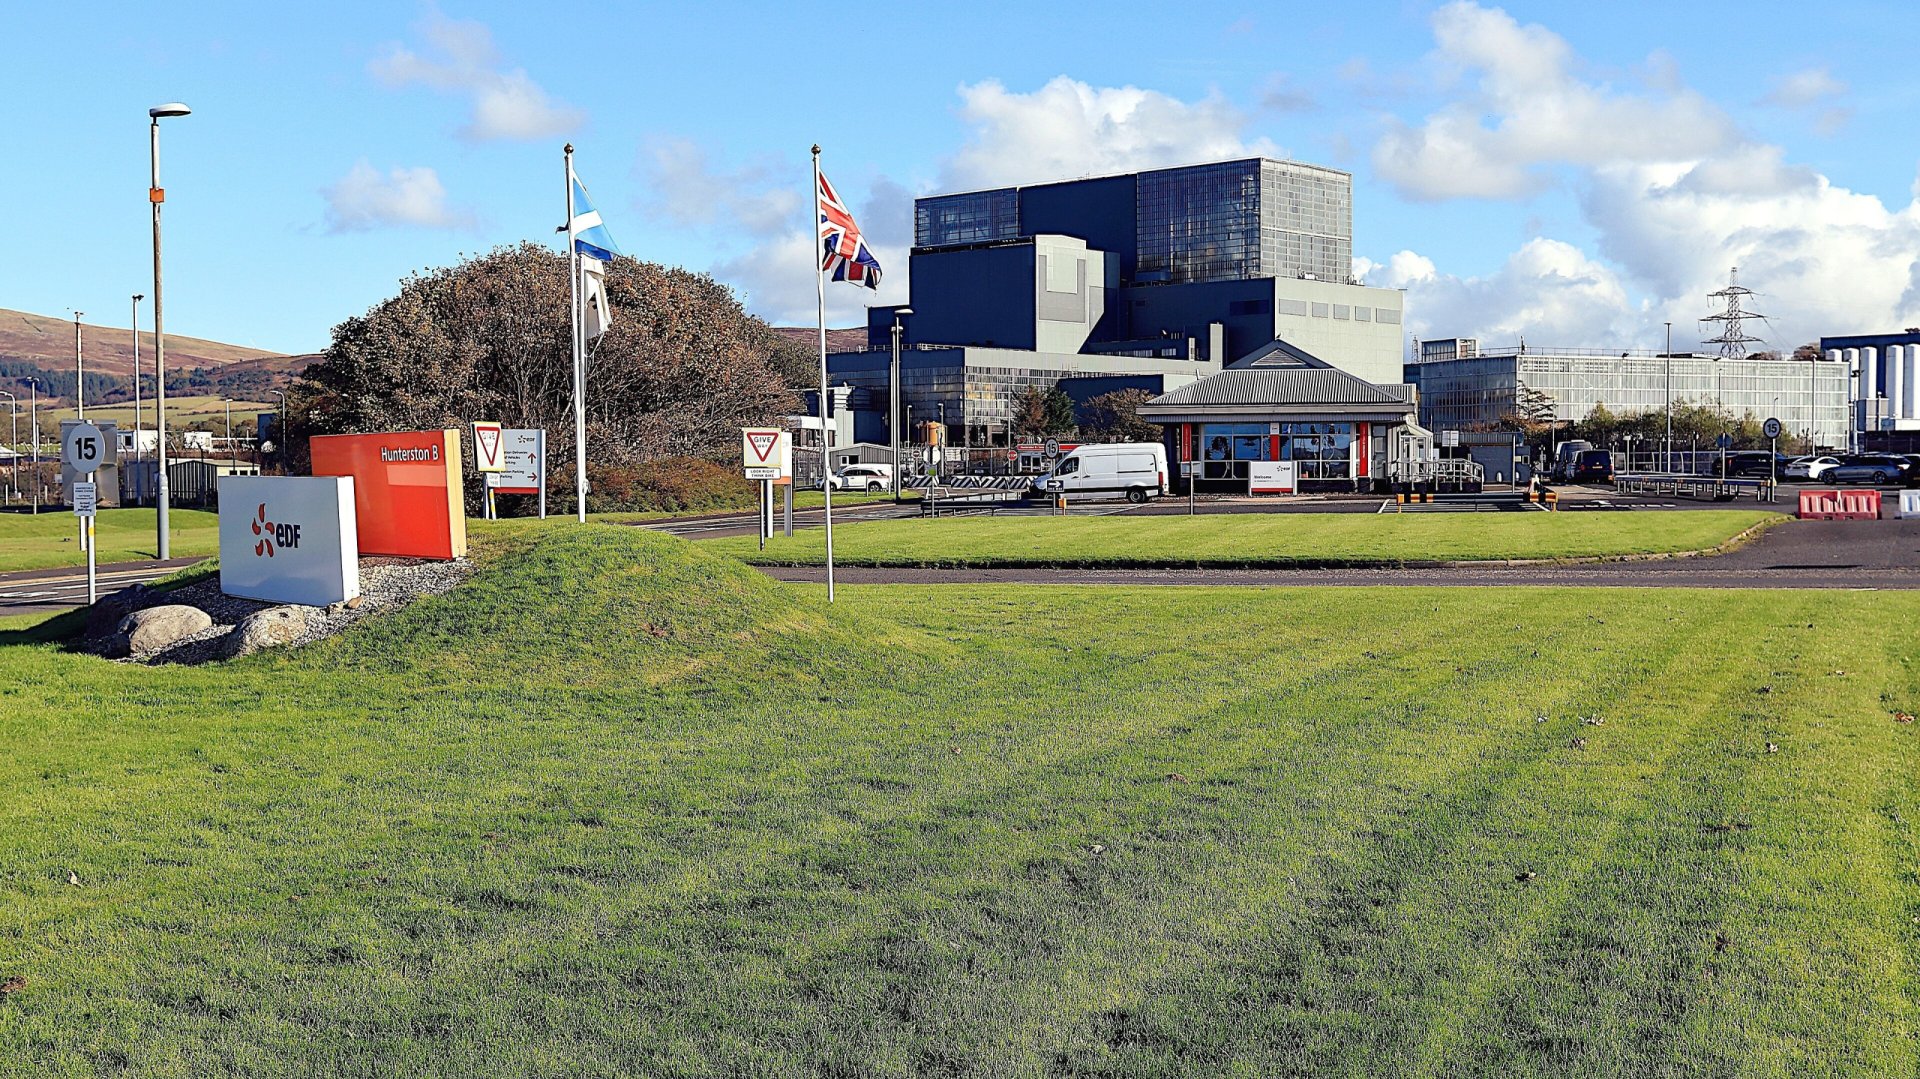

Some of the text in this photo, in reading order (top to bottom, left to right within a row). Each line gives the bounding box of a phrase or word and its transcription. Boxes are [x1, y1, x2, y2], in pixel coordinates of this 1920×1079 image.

[1767, 423, 1777, 433] 15
[75, 437, 97, 460] 15
[381, 444, 439, 462] Hunterston B
[1047, 443, 1056, 454] 15
